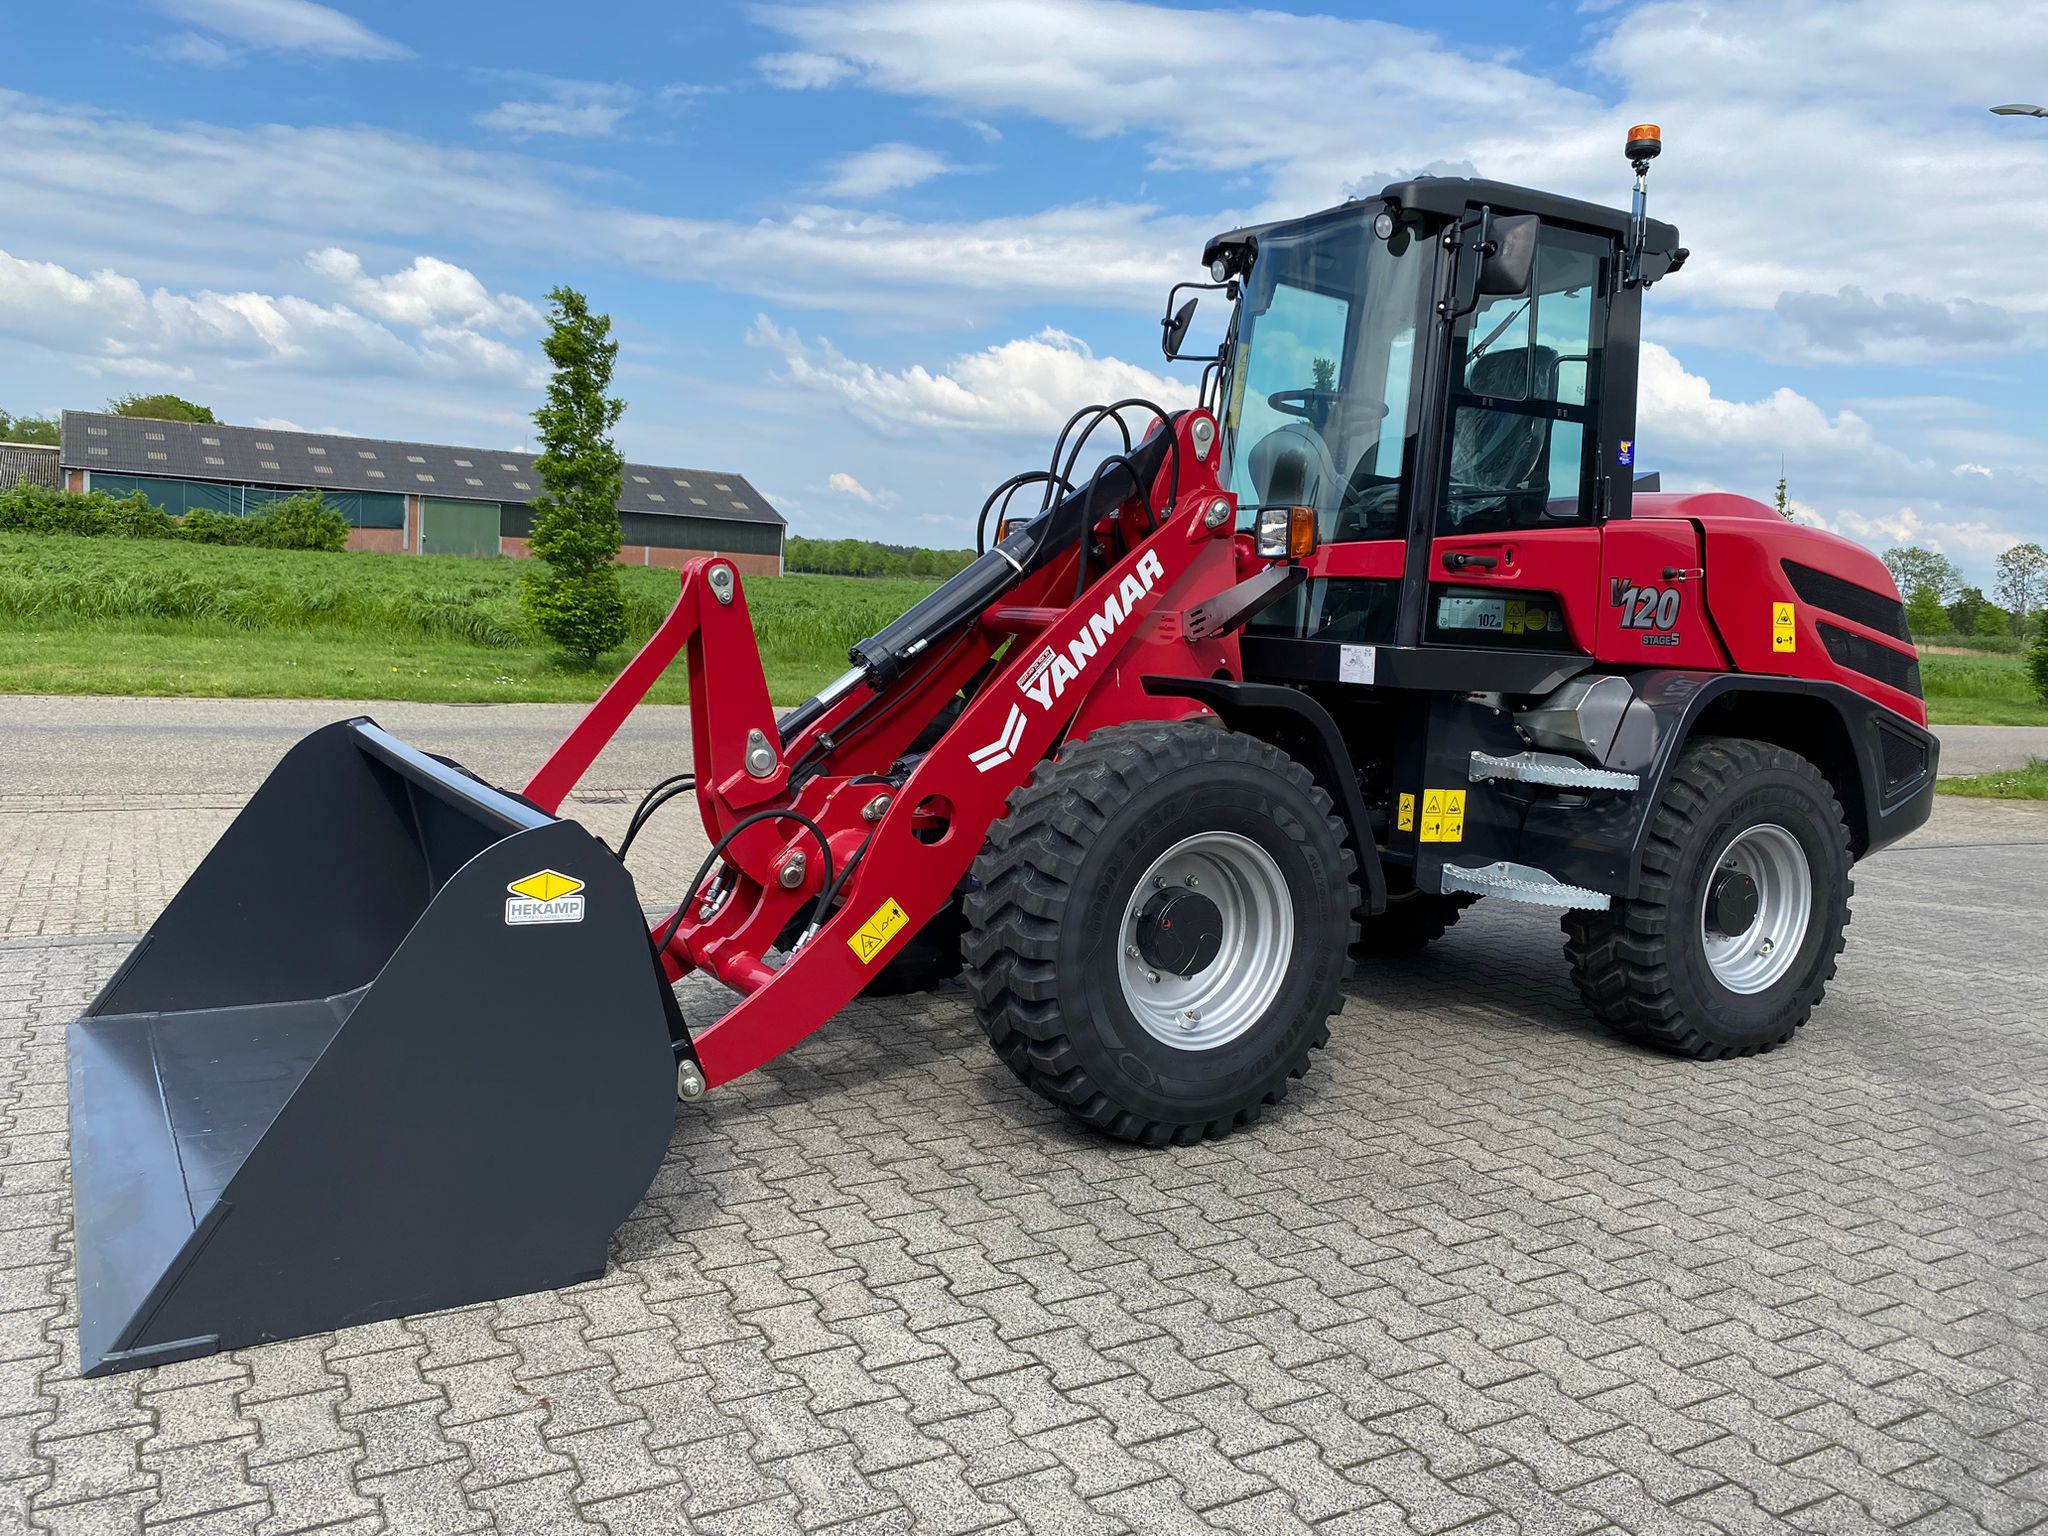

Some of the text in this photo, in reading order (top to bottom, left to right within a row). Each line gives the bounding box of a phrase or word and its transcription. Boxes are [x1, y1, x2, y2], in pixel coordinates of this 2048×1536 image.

[1478, 613, 1496, 627] 102
[1025, 548, 1165, 711] YANMAR
[511, 902, 580, 916] HEKAMP
